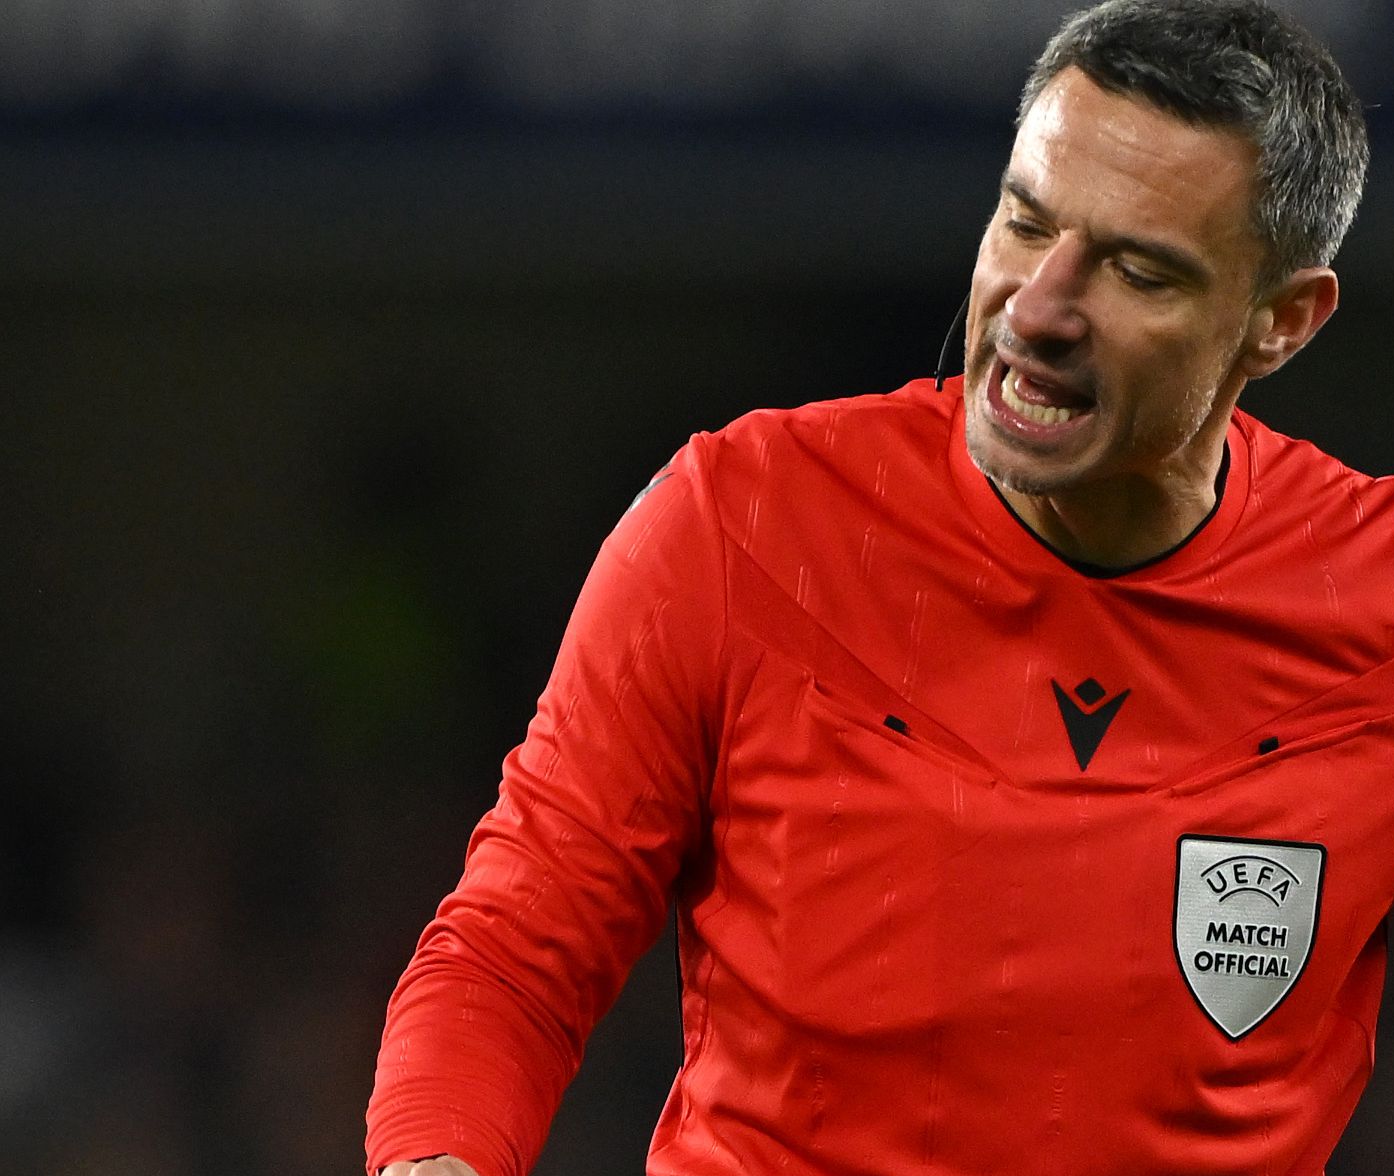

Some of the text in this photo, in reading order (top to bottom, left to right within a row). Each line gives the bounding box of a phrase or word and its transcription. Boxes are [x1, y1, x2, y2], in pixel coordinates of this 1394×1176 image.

[1206, 863, 1291, 901] UEFA
[1206, 922, 1287, 947] MATCH
[1194, 951, 1289, 977] OFFICIAL
